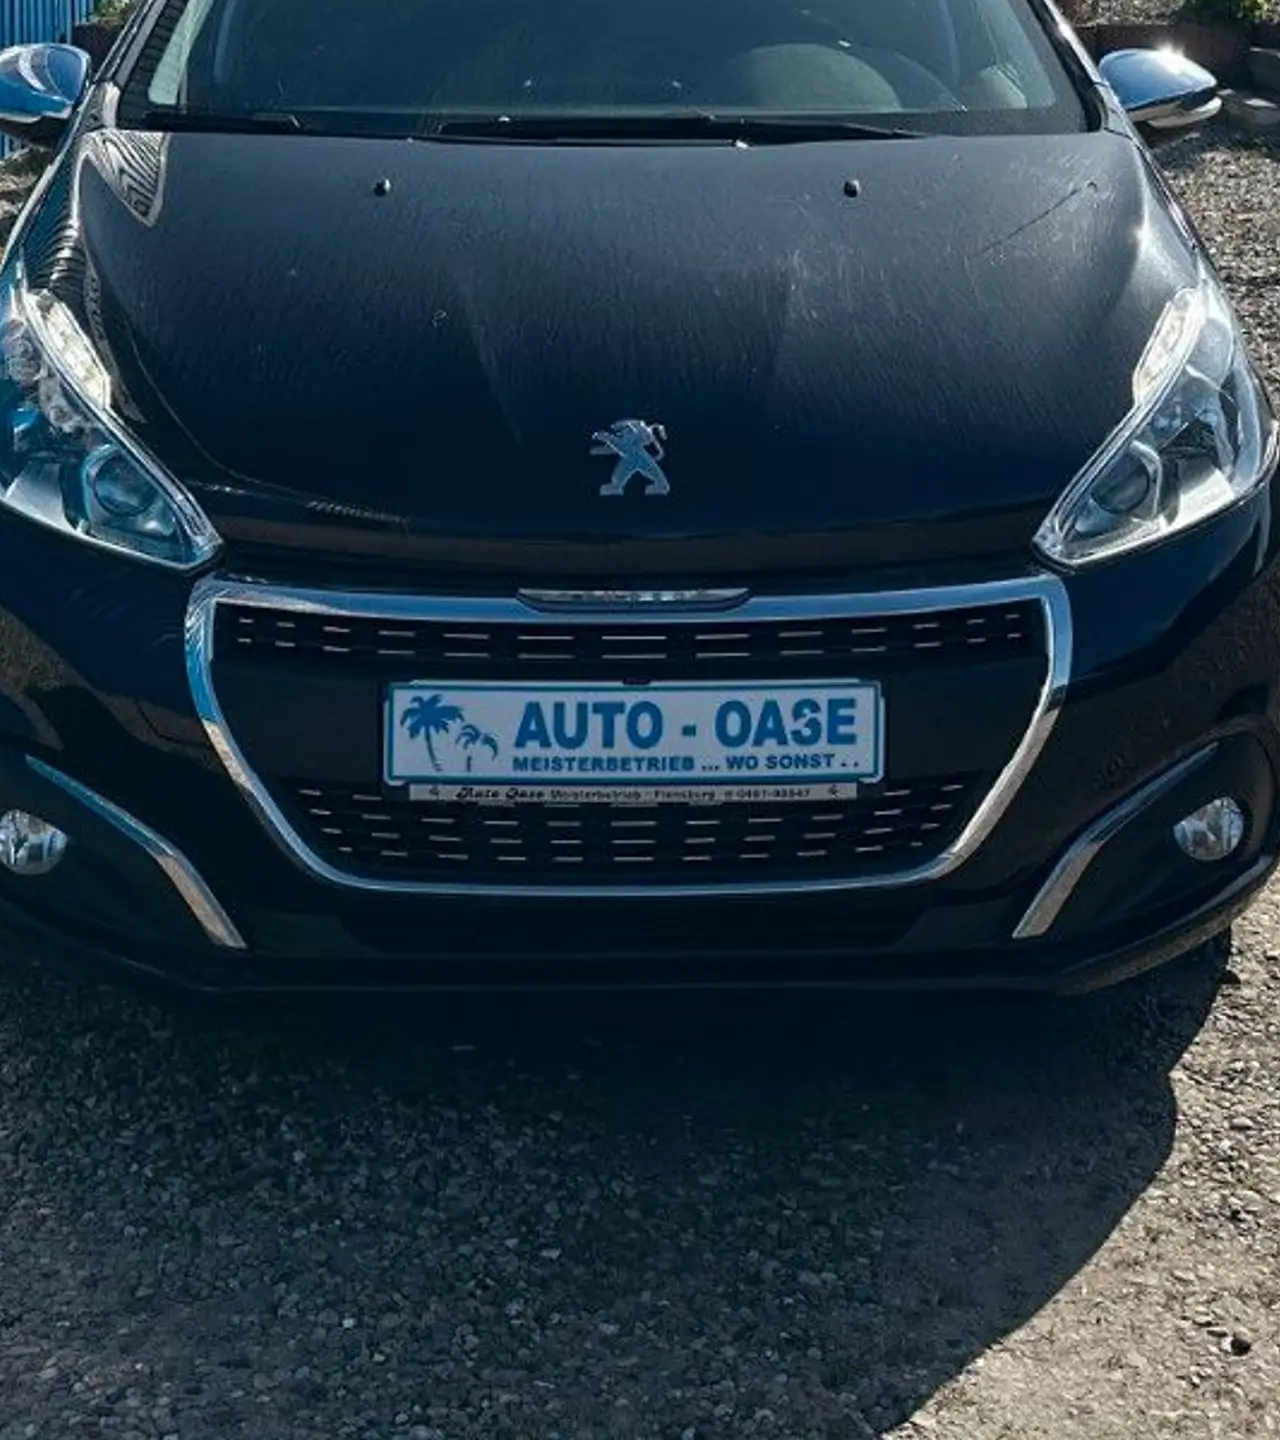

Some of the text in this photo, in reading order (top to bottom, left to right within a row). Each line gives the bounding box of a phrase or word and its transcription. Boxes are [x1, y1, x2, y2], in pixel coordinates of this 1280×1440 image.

[514, 698, 858, 750] AUTO - OASE
[512, 756, 695, 773] MEISTERBETRIEB
[726, 755, 759, 771] WO
[765, 753, 836, 770] SONST
